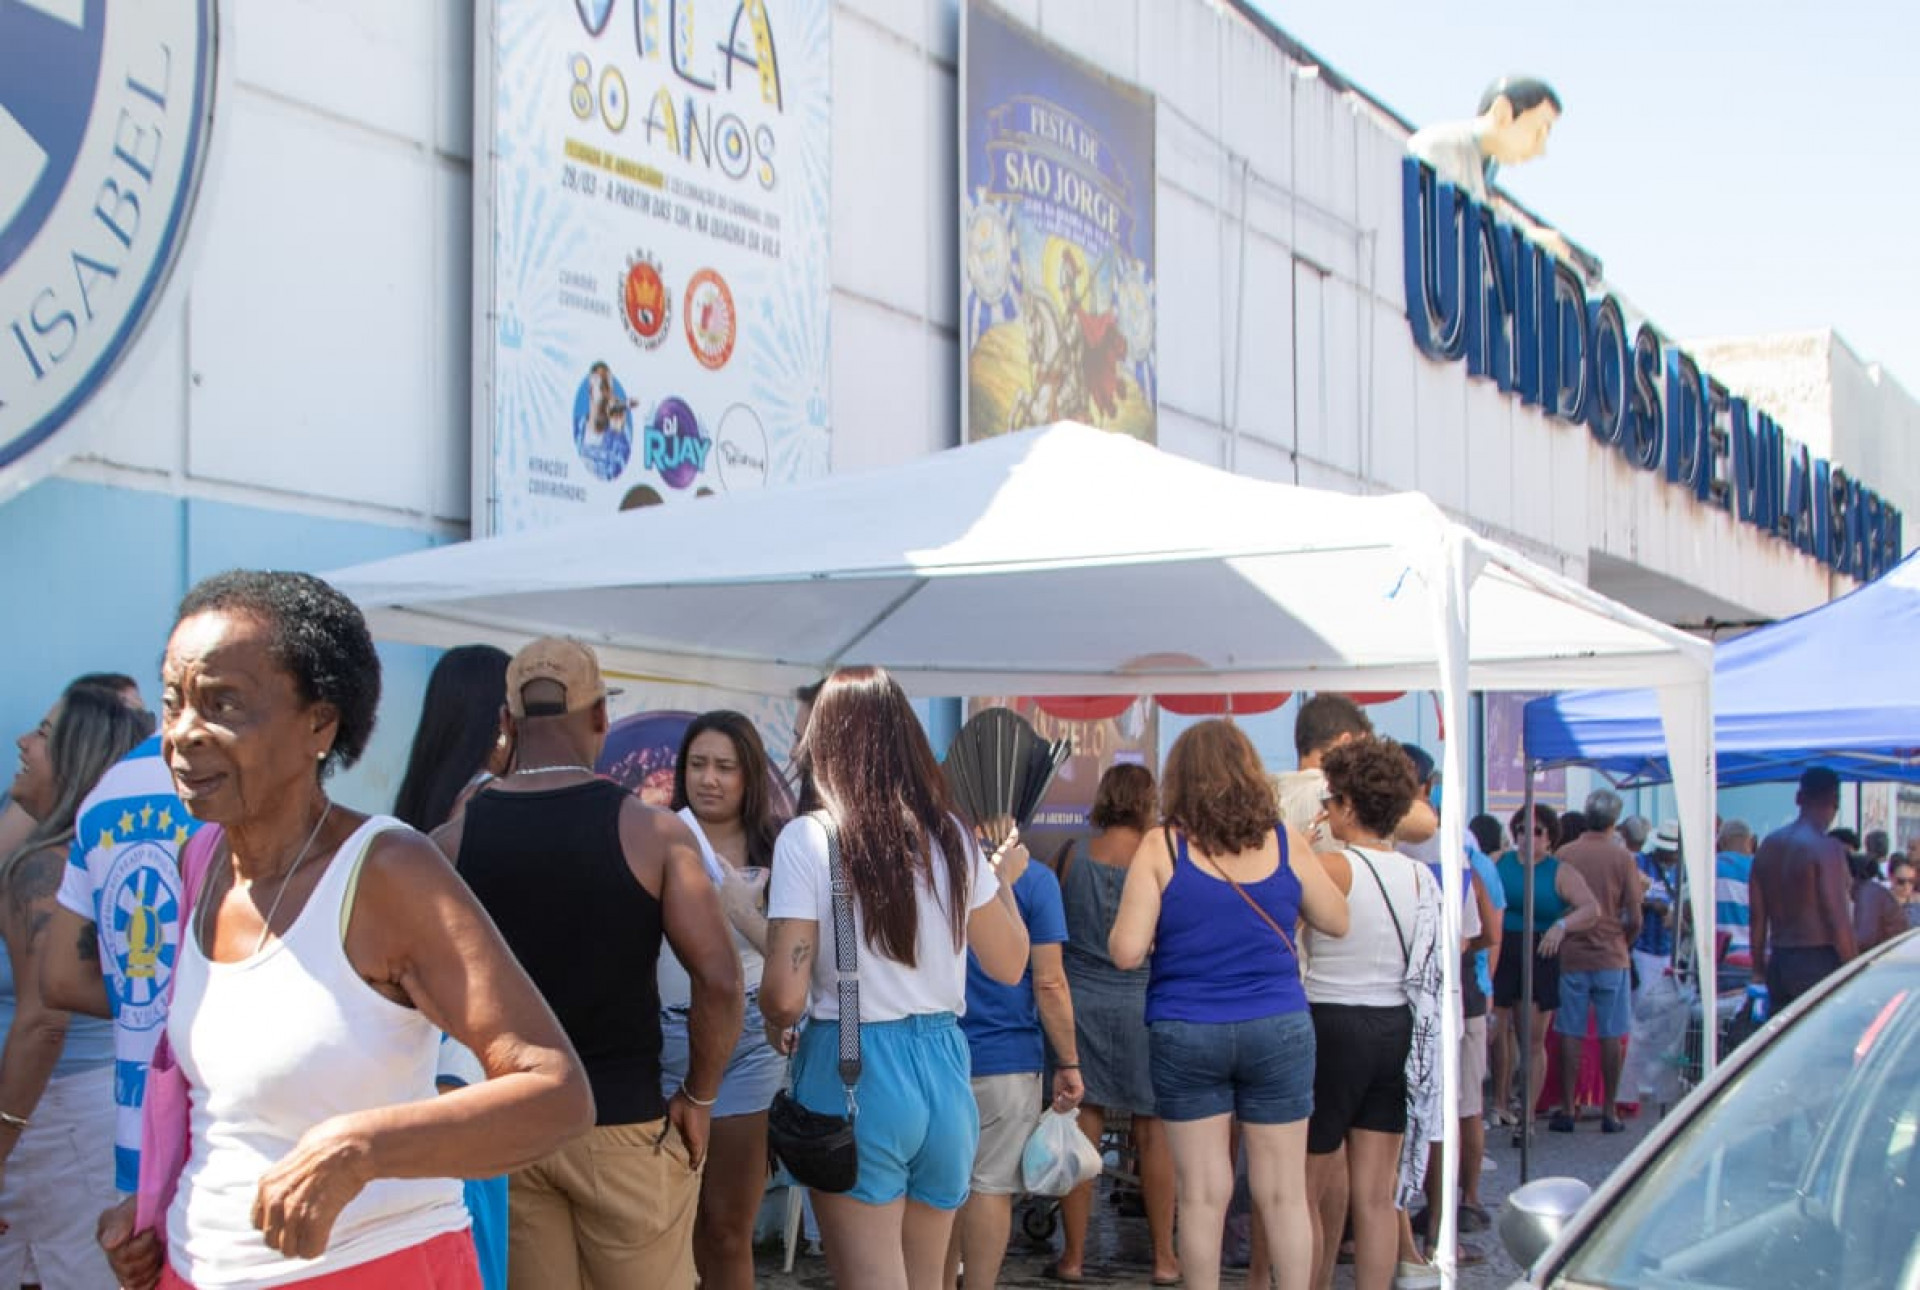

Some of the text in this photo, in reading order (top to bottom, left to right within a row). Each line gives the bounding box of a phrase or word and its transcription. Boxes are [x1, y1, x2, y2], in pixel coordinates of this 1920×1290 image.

[569, 52, 776, 192] 80 ANOS
[1031, 103, 1099, 165] FESTA DE
[11, 43, 172, 380] ISABEL
[1053, 168, 1120, 233] JORGE
[1402, 154, 1663, 474] UNIDOS
[1665, 347, 1731, 514] DE
[1730, 396, 1815, 556] VILA
[644, 424, 712, 473] RJAY
